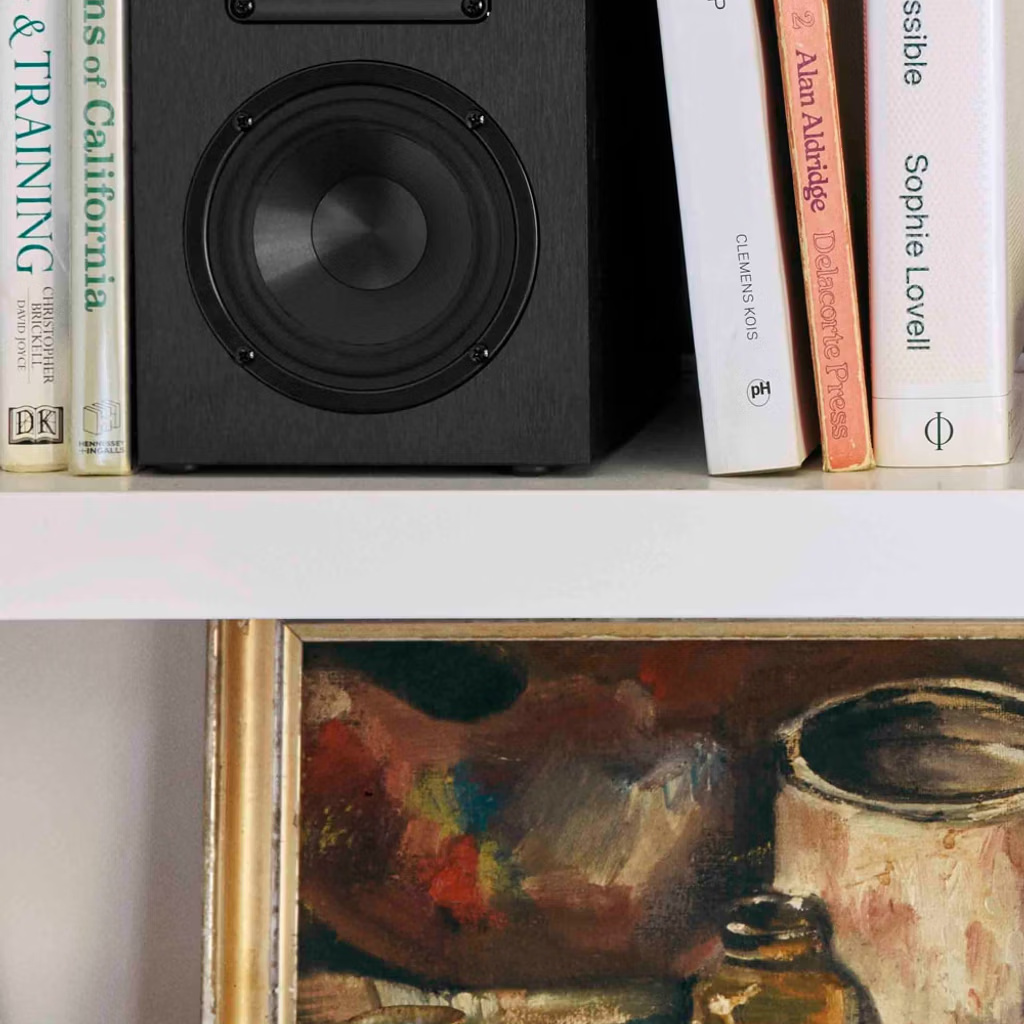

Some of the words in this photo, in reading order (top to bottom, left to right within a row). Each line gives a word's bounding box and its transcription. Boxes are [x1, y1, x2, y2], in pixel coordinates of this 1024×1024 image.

[8, 14, 47, 49] &
[83, 56, 107, 89] of
[796, 49, 817, 107] Alan
[14, 50, 55, 275] TRAINING
[801, 112, 828, 213] Aldridge
[83, 95, 116, 312] California
[898, 154, 929, 258] Sophie
[735, 234, 755, 303] CLEMENS
[812, 231, 842, 360] Delacorte
[16, 299, 26, 334] DAVID
[31, 303, 43, 368] BRICKELL
[43, 286, 55, 384] CHRISTOPHER
[744, 307, 759, 341] KOIS
[905, 266, 930, 351] Lovell
[15, 337, 27, 371] JOYCE
[16, 408, 57, 435] DK
[822, 363, 850, 440] Press
